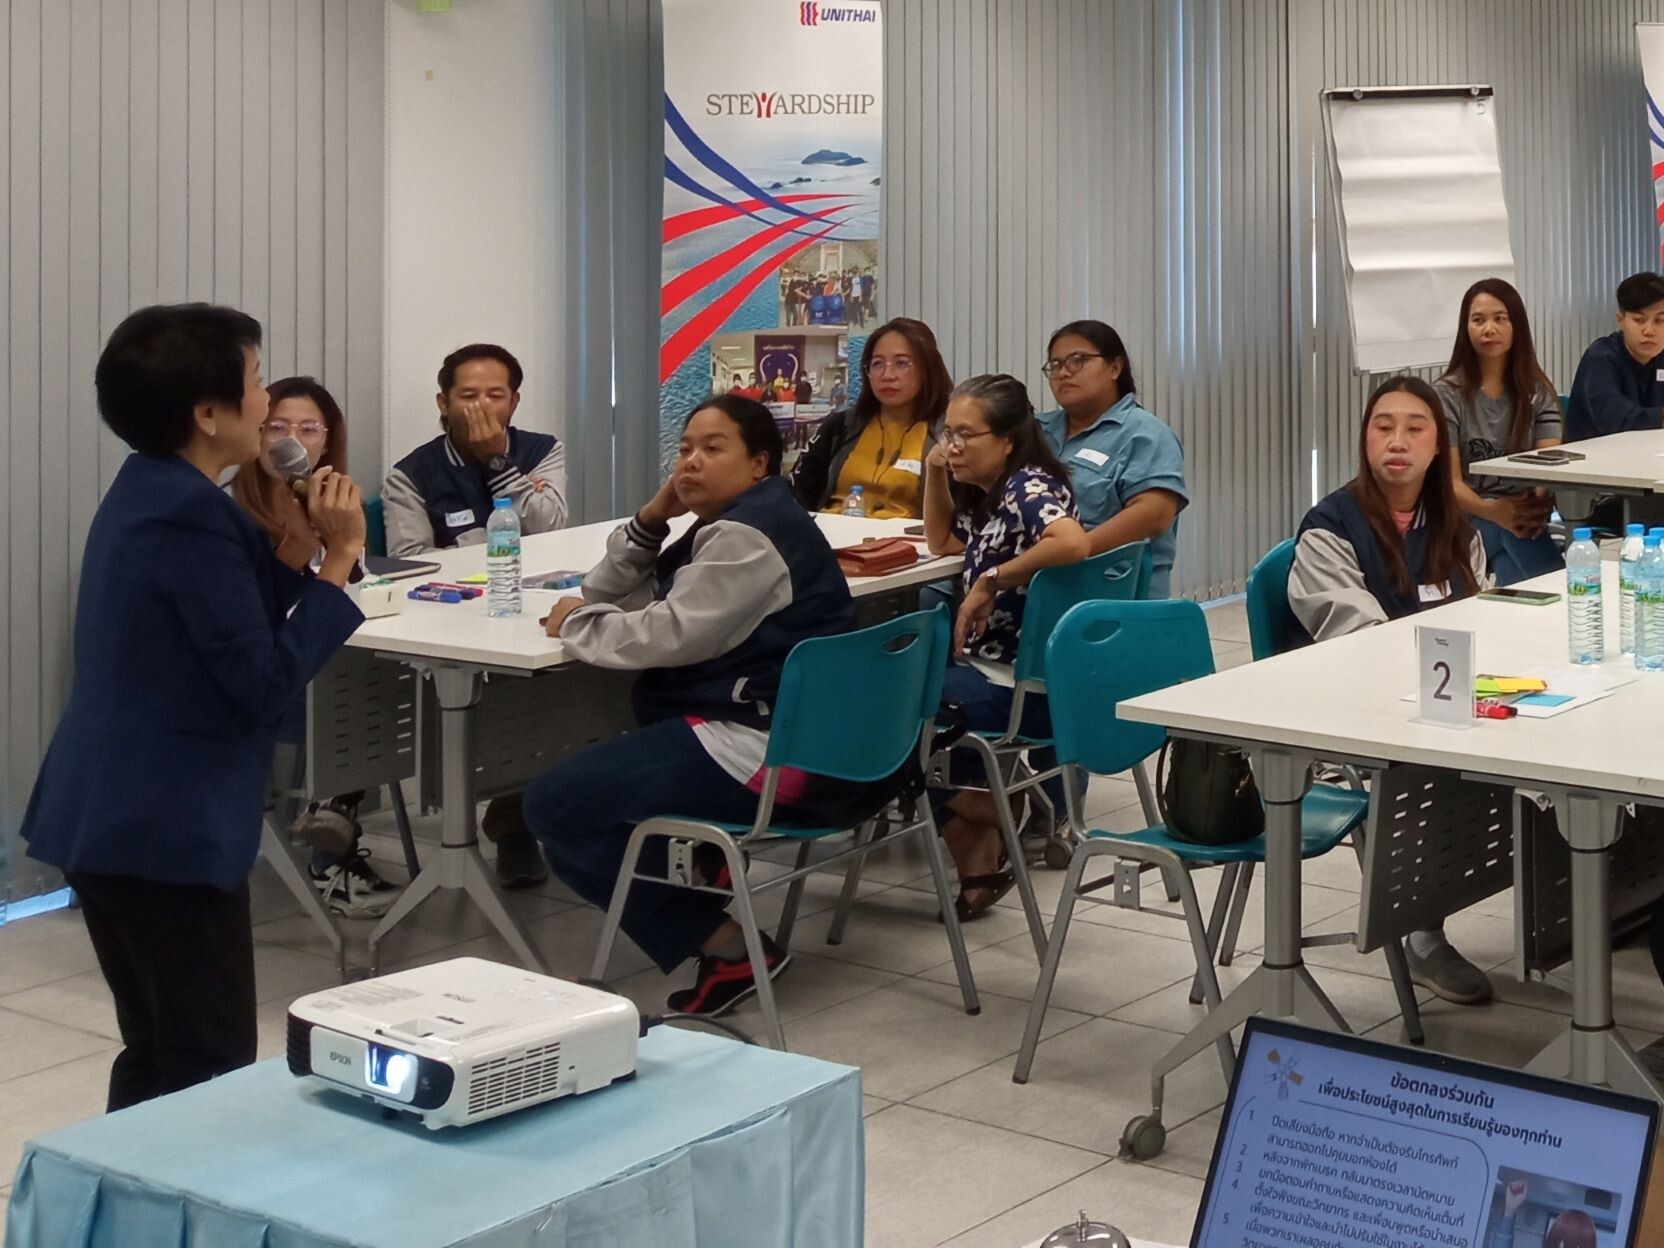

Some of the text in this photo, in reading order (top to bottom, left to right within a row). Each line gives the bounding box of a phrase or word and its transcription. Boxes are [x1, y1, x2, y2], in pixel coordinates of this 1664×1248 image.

[820, 8, 876, 23] UNITHAI
[706, 91, 875, 118] STEWARDSHIP
[1433, 661, 1452, 701] 2
[1390, 1070, 1495, 1110] ข้อตกลงร่วมกัน
